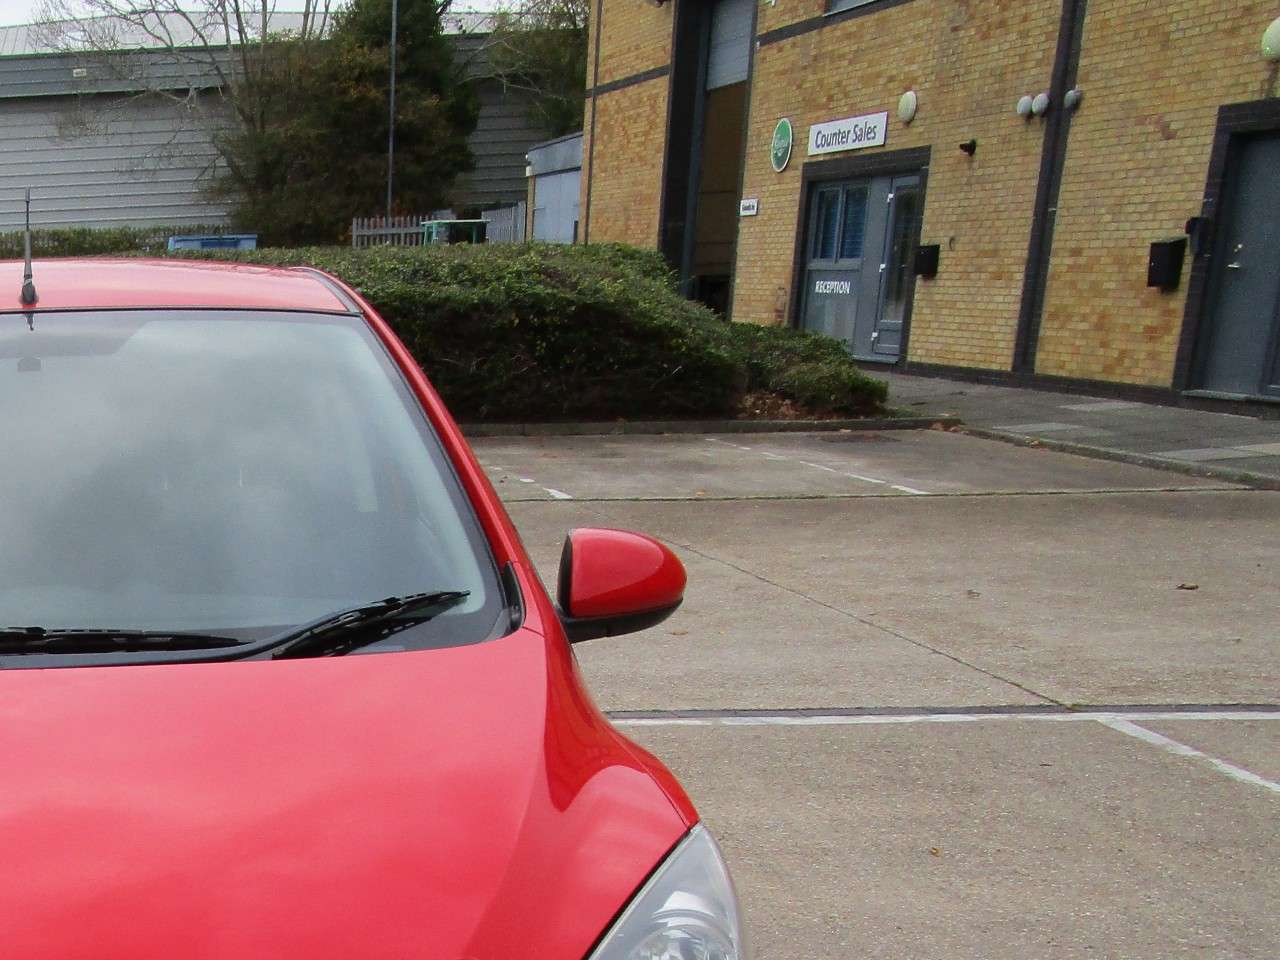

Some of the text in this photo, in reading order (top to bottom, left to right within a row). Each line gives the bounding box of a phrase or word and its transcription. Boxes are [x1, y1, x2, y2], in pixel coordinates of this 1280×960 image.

[815, 129, 850, 149] Counter
[852, 121, 877, 144] Sales
[815, 280, 851, 294] RECEPTION
